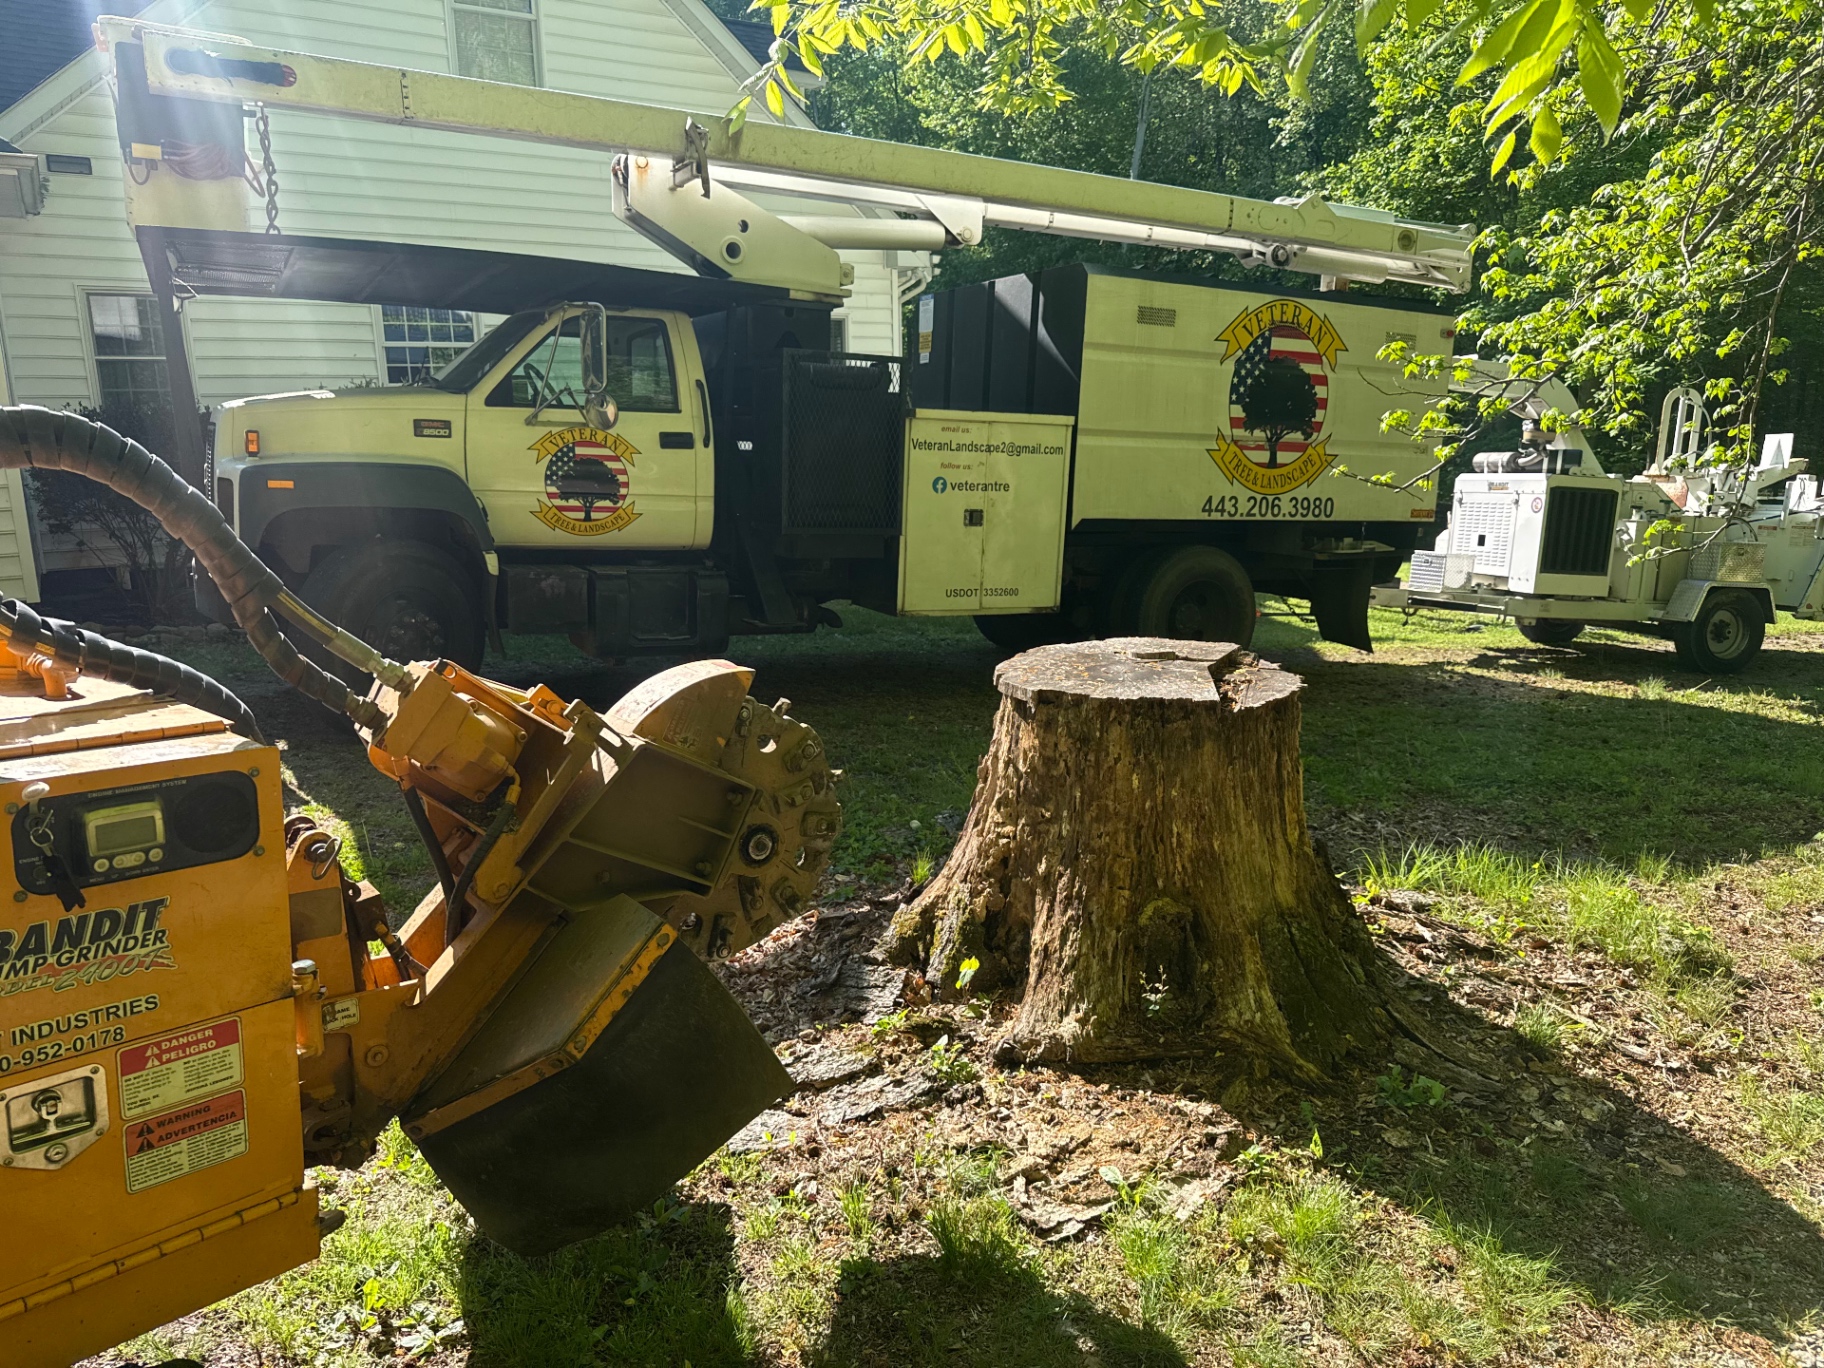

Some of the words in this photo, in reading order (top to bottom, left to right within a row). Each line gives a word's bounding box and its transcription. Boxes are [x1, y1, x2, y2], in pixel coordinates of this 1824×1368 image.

[1242, 303, 1327, 347] VETERAN
[941, 425, 960, 433] email
[549, 428, 622, 452] VETERAN
[911, 438, 1064, 457] VeteranLandscape2@gmail.com
[940, 462, 961, 470] follow
[1228, 452, 1251, 483] TREE
[1251, 472, 1261, 487] &
[1260, 454, 1316, 489] LANDSCAPE
[950, 480, 1010, 492] veterantre
[1201, 495, 1334, 519] 443.206.3980
[550, 512, 571, 530] TREE
[577, 513, 625, 533] LANDSCAPE
[945, 588, 980, 598] USDOT
[983, 588, 1019, 597] 3352600
[88, 790, 113, 798] ENGINE
[115, 783, 161, 794] MANAGEMENT
[162, 779, 187, 788] SYSTEM
[19, 856, 40, 864] ENGINE
[56, 929, 167, 968] GRINDER
[0, 975, 53, 995] DEL
[11, 995, 159, 1046] INDUSTRIES
[0, 1026, 125, 1072] 0-952-0178
[161, 1029, 214, 1050] DANGER
[162, 1040, 217, 1062] PELIGRO
[156, 1105, 212, 1128] WARNING
[157, 1111, 238, 1143] ADVERTENCIA
